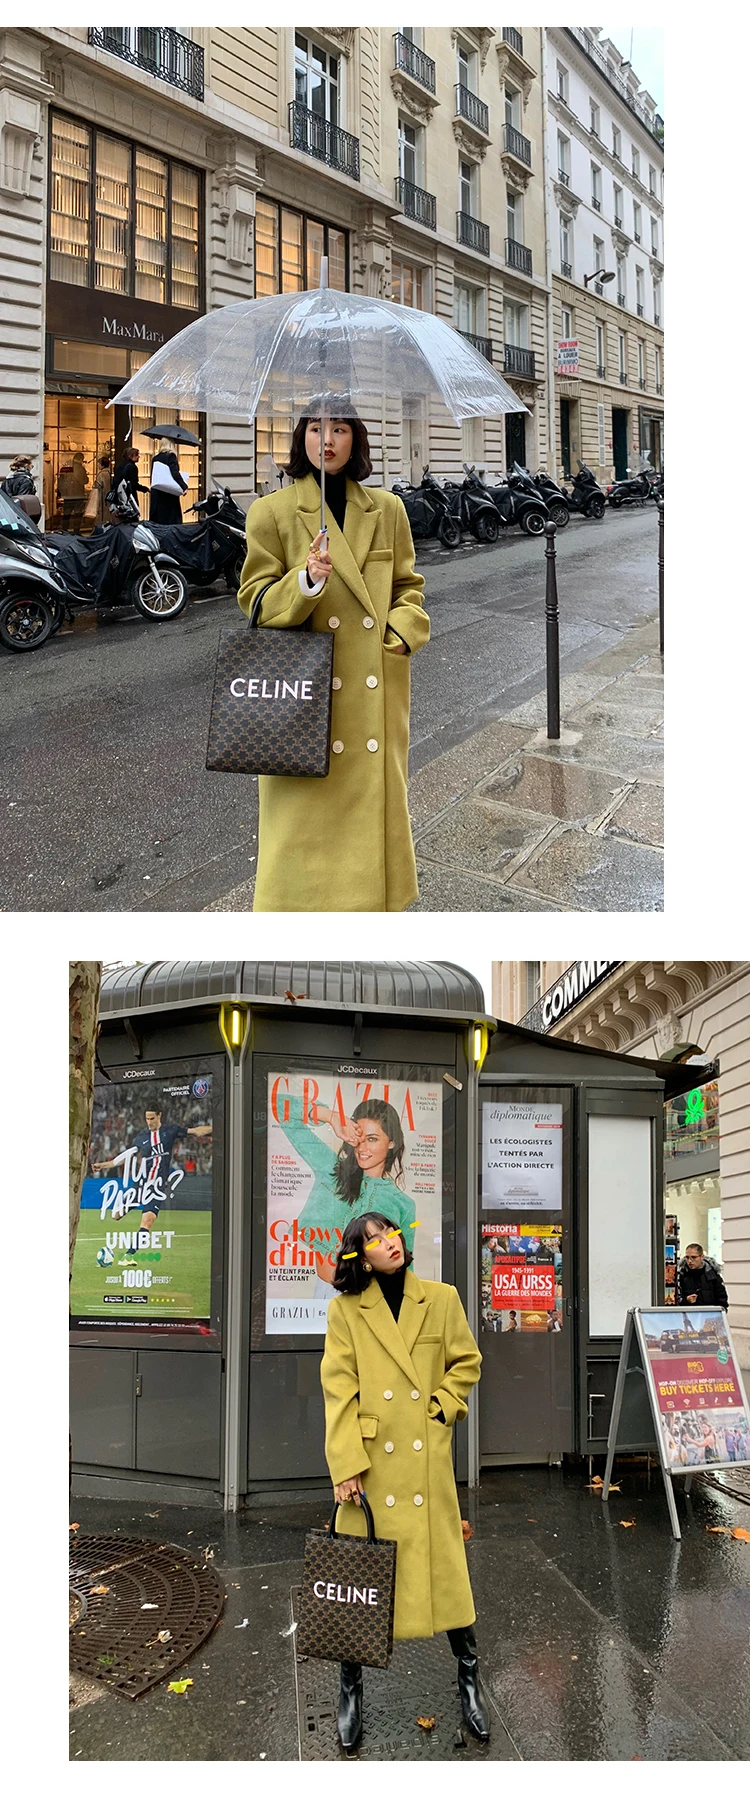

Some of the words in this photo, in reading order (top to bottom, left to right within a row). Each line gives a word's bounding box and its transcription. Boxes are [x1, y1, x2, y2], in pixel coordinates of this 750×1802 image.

[102, 316, 164, 342] MaxMara
[230, 678, 313, 700] CELINE
[542, 961, 615, 1026] COMM
[123, 1070, 156, 1079] JCDecaux
[337, 1065, 378, 1075] JCDecaux
[490, 1110, 553, 1122] diplomatique
[504, 1137, 553, 1145] ÉCOLOGISTES
[113, 1146, 147, 1188] TU
[277, 1171, 312, 1179] changement
[482, 1224, 517, 1233] Historia
[105, 1231, 175, 1249] UNIBET
[122, 1269, 152, 1288] 100€
[272, 1307, 309, 1319] GRAZIA
[660, 1385, 677, 1396] BUY
[679, 1383, 713, 1394] TICKETS
[714, 1382, 736, 1392] HERE
[313, 1580, 378, 1605] CELINE
